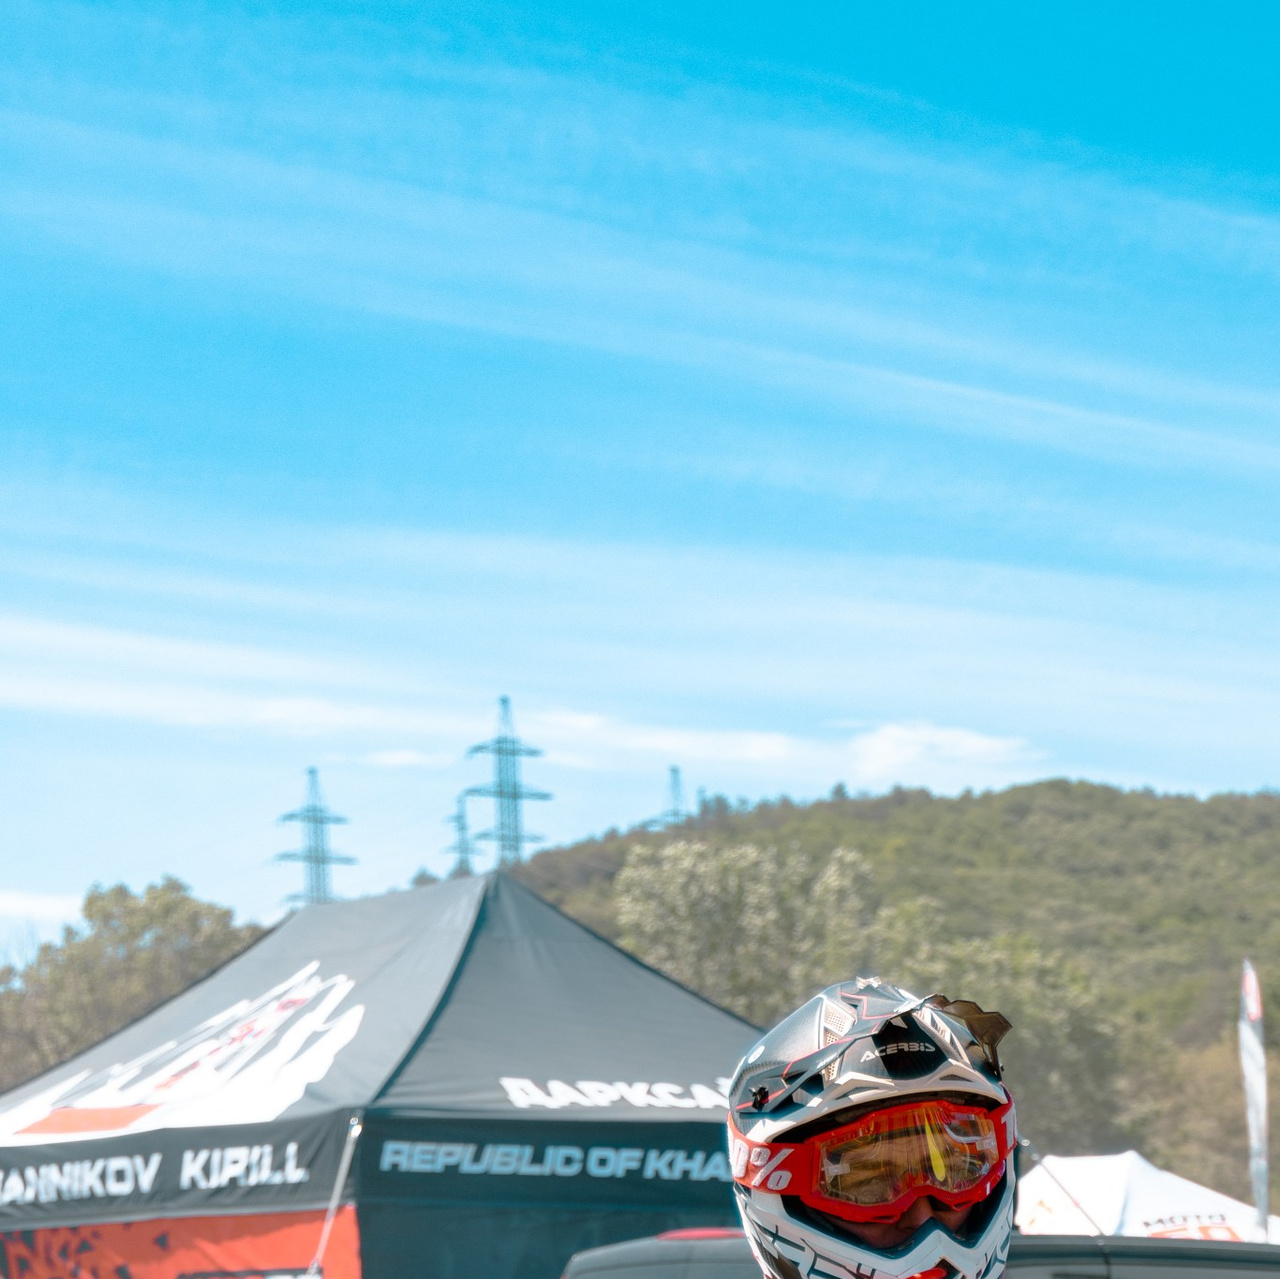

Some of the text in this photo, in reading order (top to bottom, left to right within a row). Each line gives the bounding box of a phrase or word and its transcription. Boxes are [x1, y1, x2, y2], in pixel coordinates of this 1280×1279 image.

[0, 1141, 310, 1205] ANNIKOV KIRILL
[379, 1140, 733, 1181] REPUBLIC OF KHA
